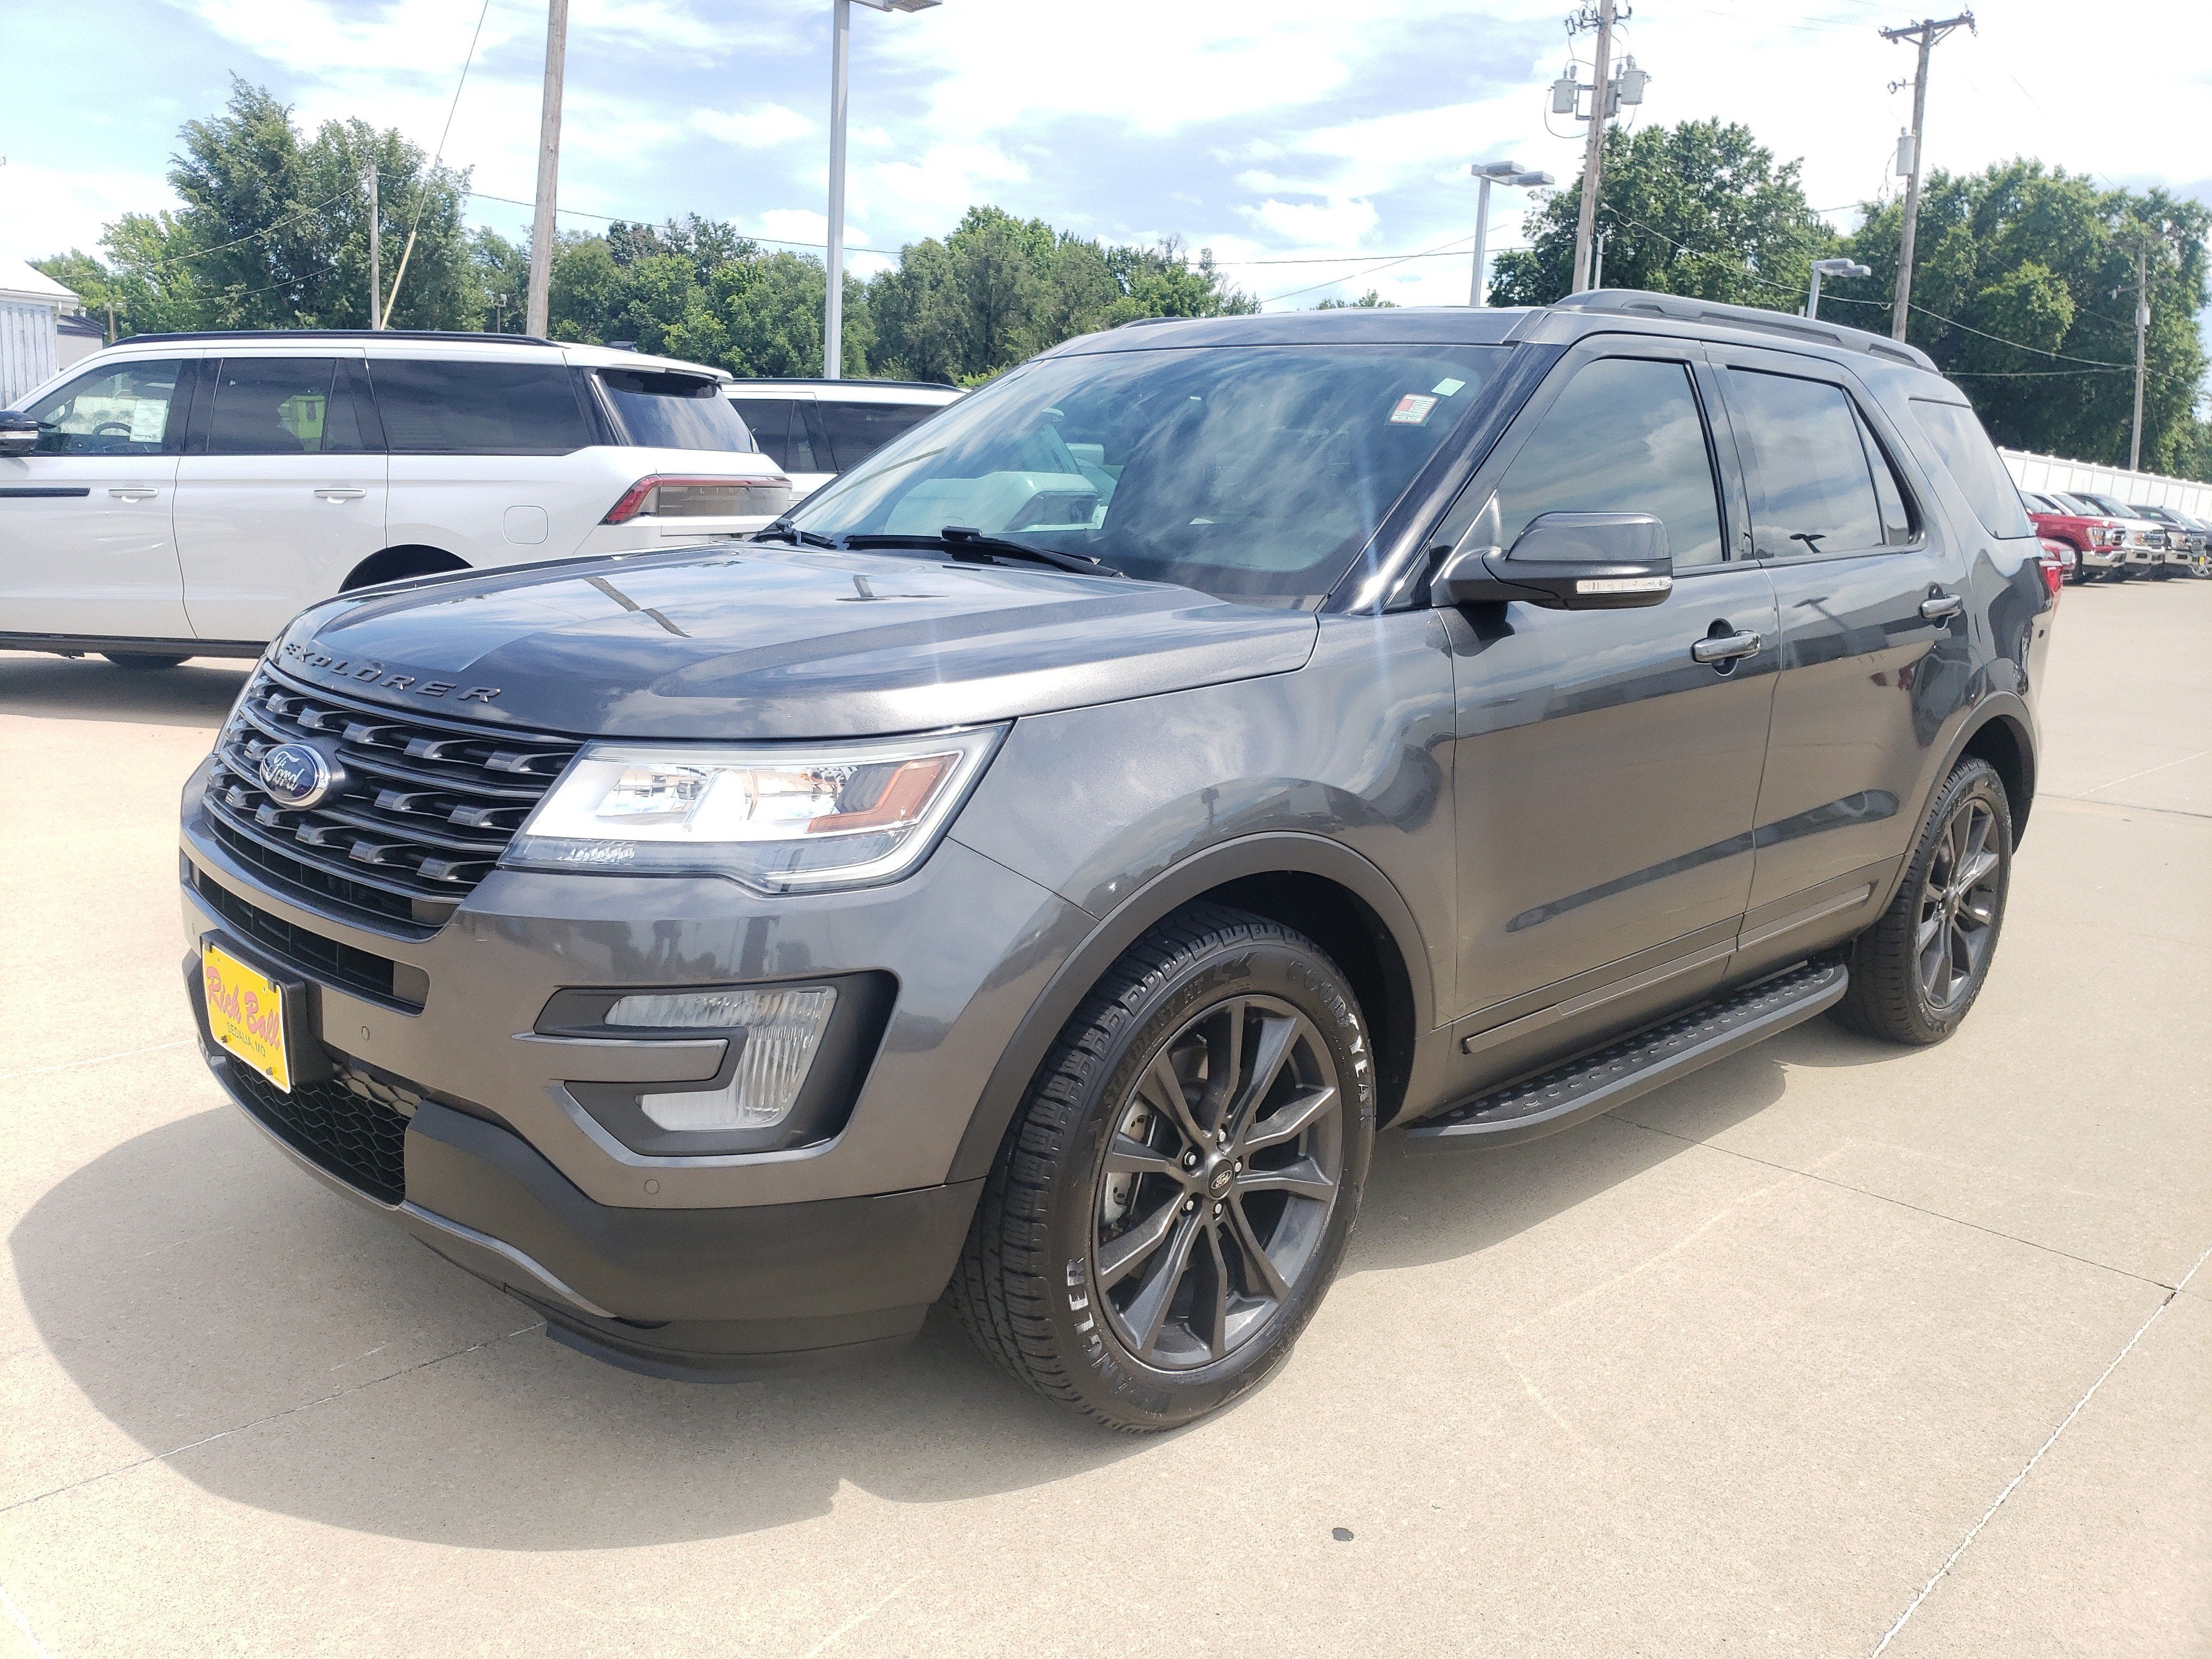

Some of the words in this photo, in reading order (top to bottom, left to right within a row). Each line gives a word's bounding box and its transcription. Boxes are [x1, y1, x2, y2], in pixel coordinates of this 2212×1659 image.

[285, 643, 501, 702] EXPLORER
[263, 751, 306, 792] Ford
[227, 1022, 255, 1052] SEDALIA,
[256, 1043, 266, 1058] MO
[244, 991, 280, 1050] Ball
[1287, 960, 1373, 1127] GOODYEAR
[1215, 1172, 1229, 1187] Ford
[1066, 1257, 1172, 1415] ANGLER
